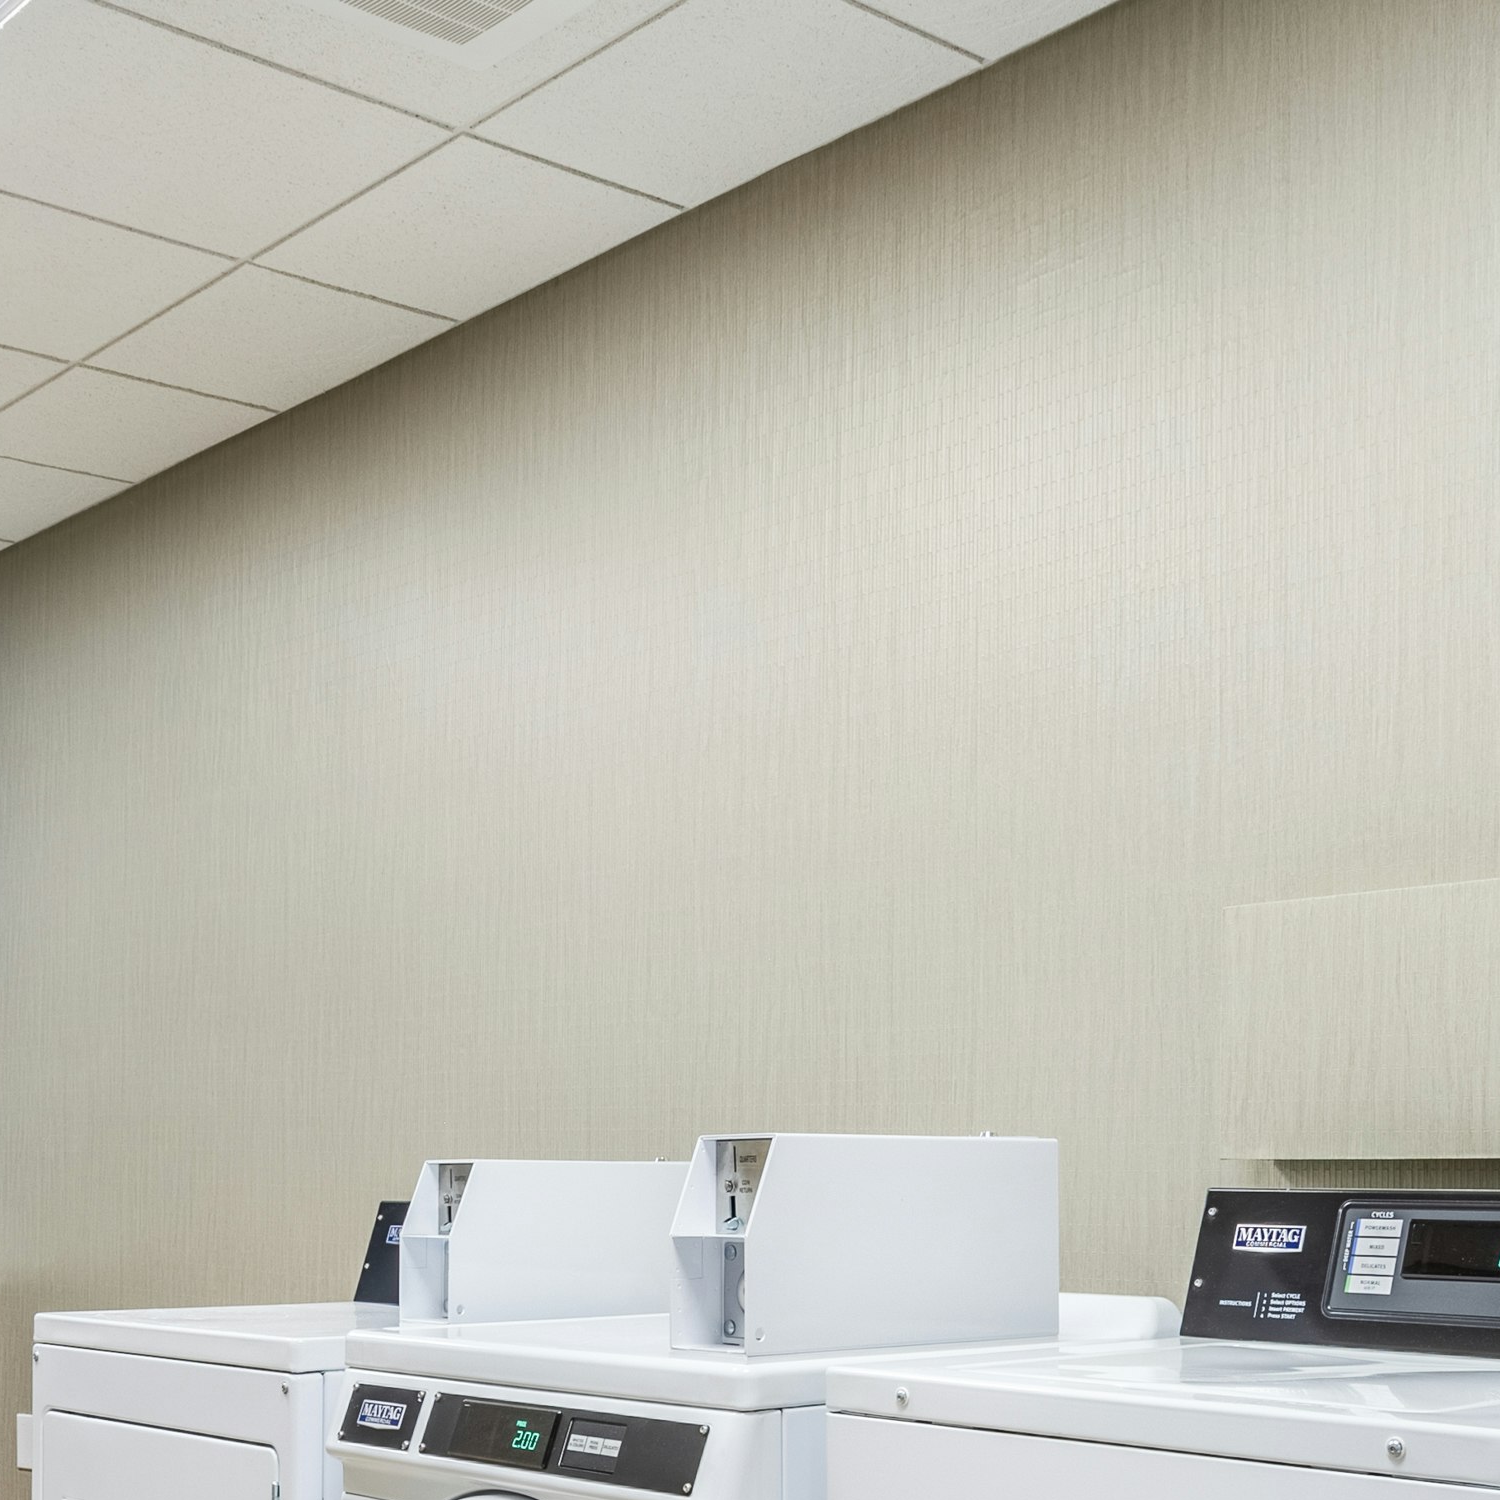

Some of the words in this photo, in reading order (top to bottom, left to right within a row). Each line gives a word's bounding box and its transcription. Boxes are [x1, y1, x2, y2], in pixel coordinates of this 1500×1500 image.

[1371, 1211, 1395, 1219] CYCLES
[1237, 1227, 1300, 1243] MAYTAG
[361, 1403, 402, 1420] MAYTAG
[511, 1430, 540, 1451] 2.00
